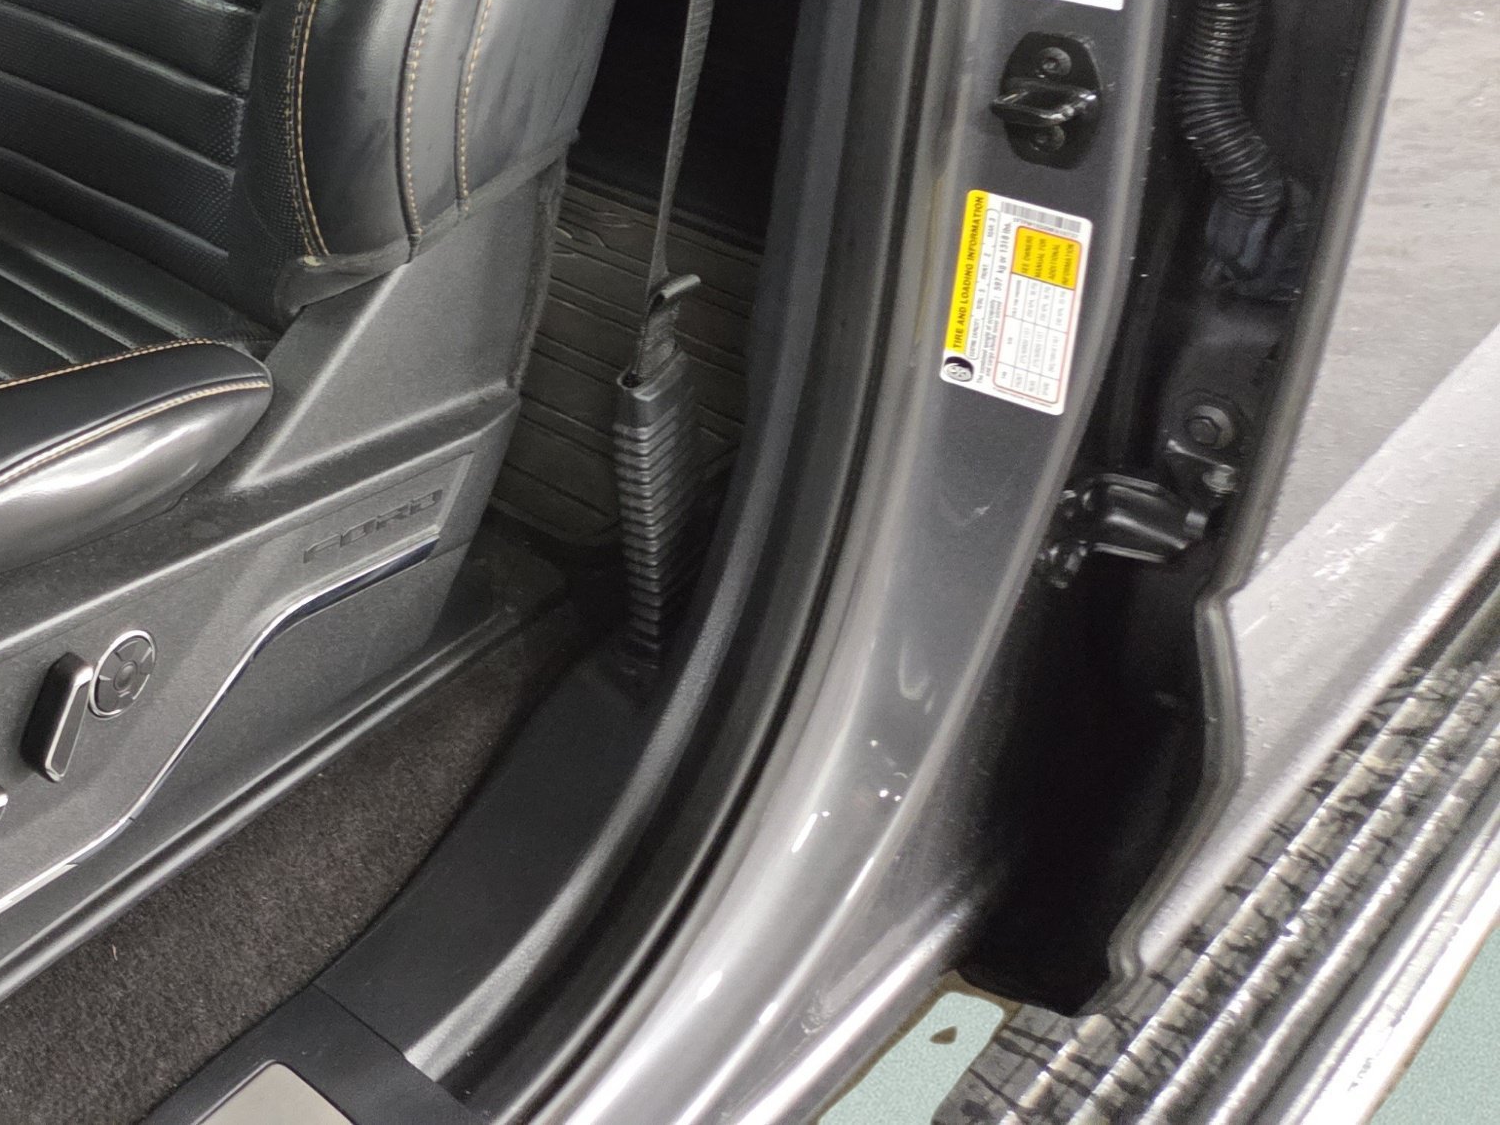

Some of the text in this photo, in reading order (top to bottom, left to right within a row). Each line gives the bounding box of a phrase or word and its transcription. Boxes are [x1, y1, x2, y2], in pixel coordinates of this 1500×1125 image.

[953, 196, 984, 348] TIRE AND LOADING INFORMATION
